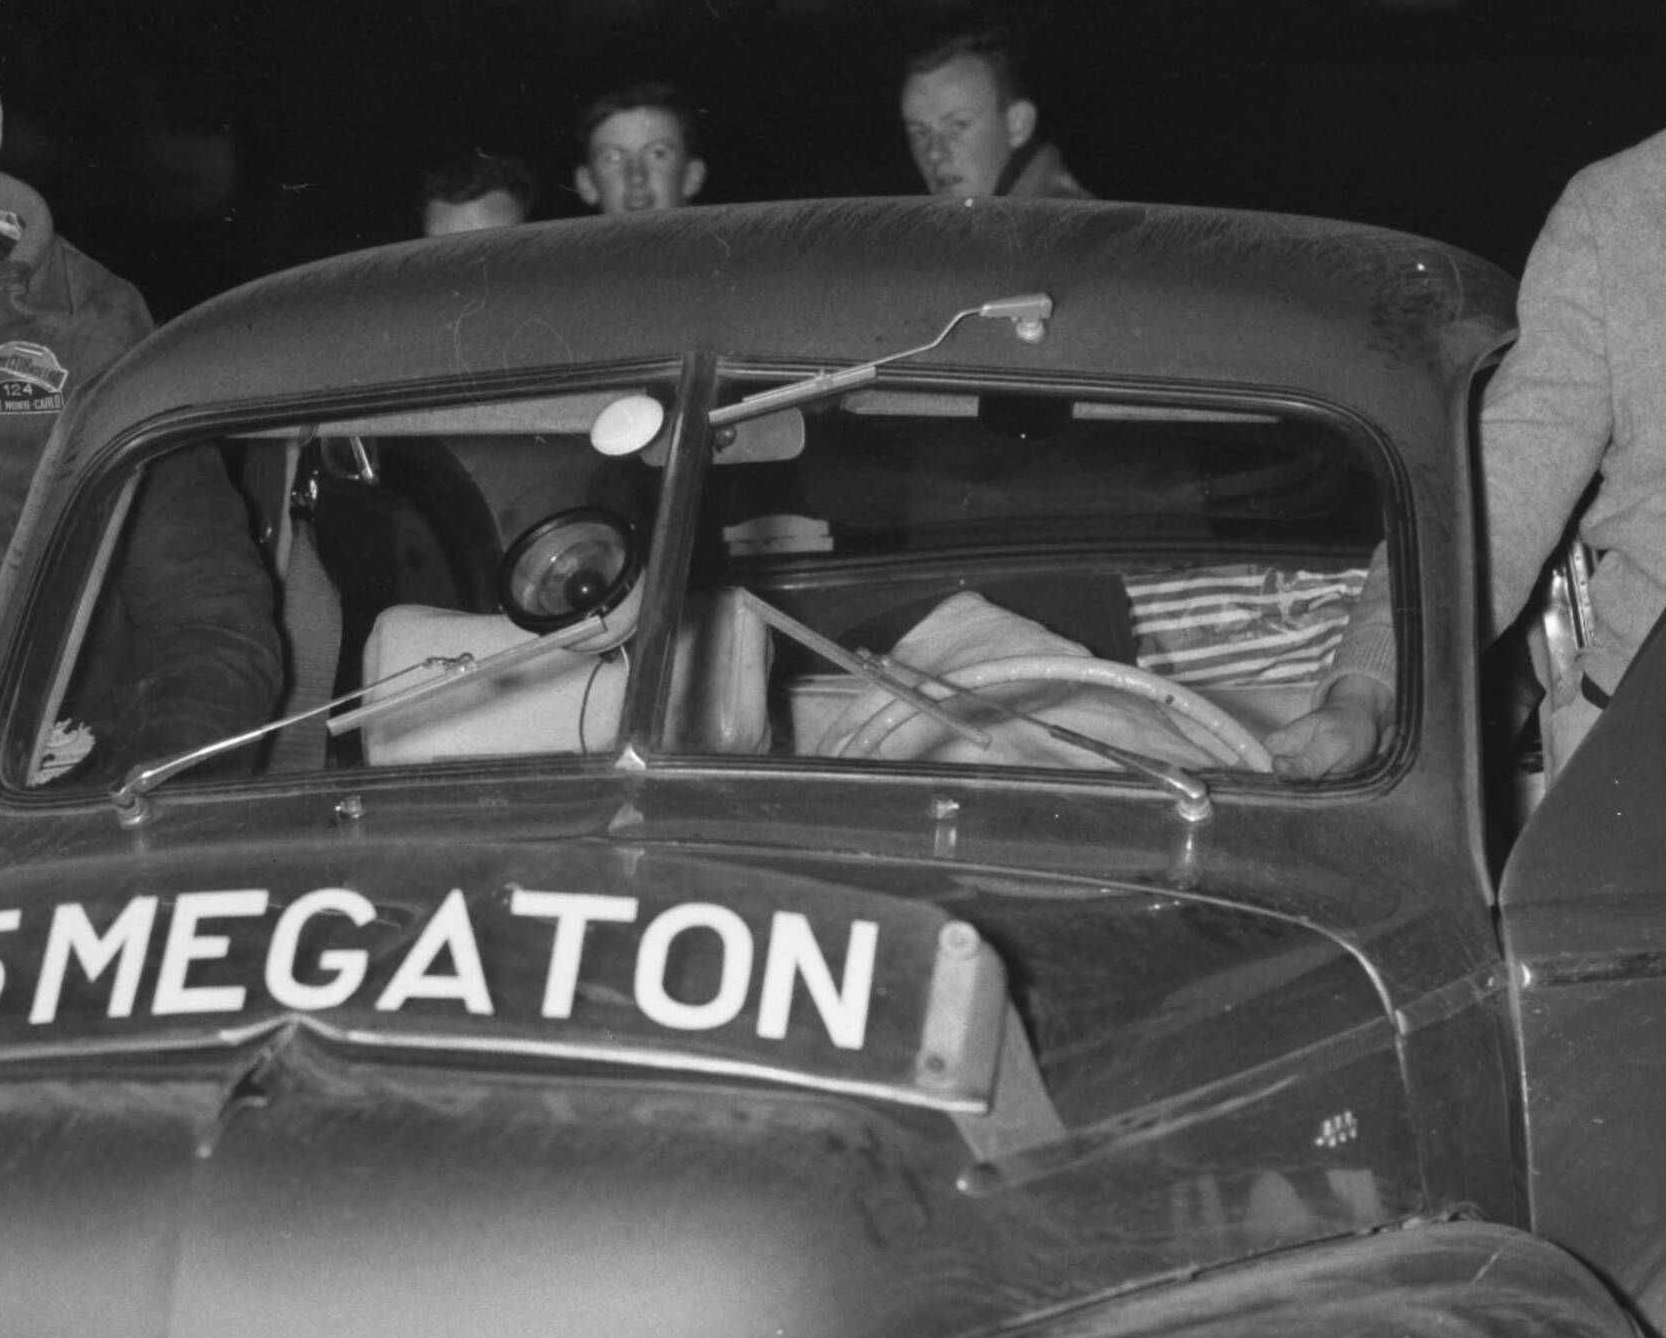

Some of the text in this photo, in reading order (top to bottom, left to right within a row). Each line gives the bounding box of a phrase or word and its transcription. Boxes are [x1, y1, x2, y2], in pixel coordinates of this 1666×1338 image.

[2, 383, 33, 397] 124
[4, 393, 61, 411] MONTE-CARLO
[27, 887, 880, 1051] MEGATON
